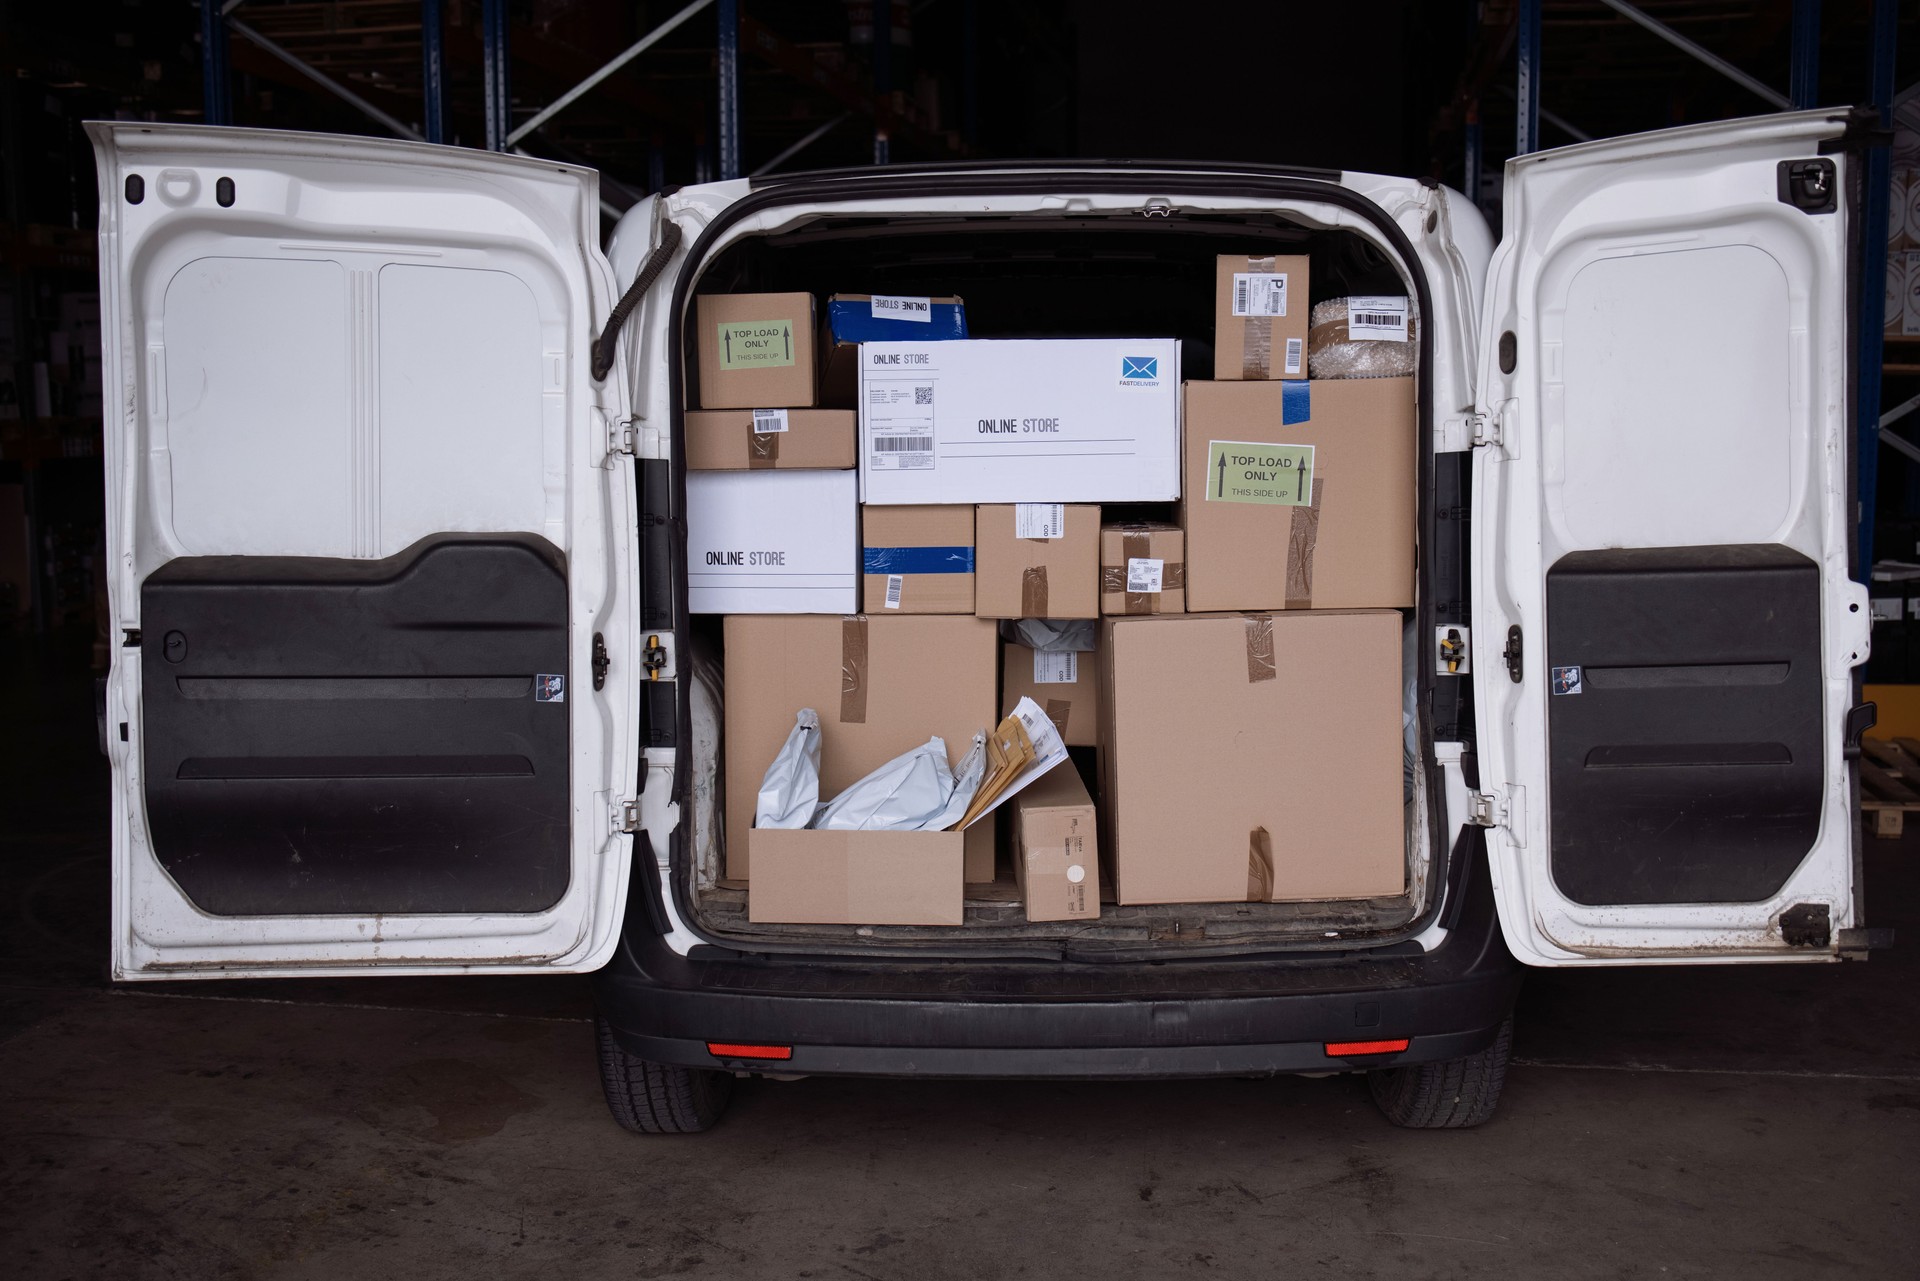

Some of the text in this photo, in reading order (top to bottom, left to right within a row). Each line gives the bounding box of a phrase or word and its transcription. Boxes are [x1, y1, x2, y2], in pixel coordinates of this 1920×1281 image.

[1271, 279, 1283, 289] P
[875, 298, 928, 312] ONLINE STORE
[733, 328, 779, 338] TOP LOAD
[744, 340, 769, 348] ONLY
[736, 353, 752, 361] THIS
[873, 353, 930, 365] ONLINE STORE
[978, 418, 1060, 434] ONLINE STORE
[1231, 456, 1292, 468] TOP LOAD
[1244, 471, 1277, 481] ONLY
[1231, 488, 1251, 496] THIS
[1253, 489, 1274, 497] SIDE
[705, 551, 786, 566] ONLINE STORE
